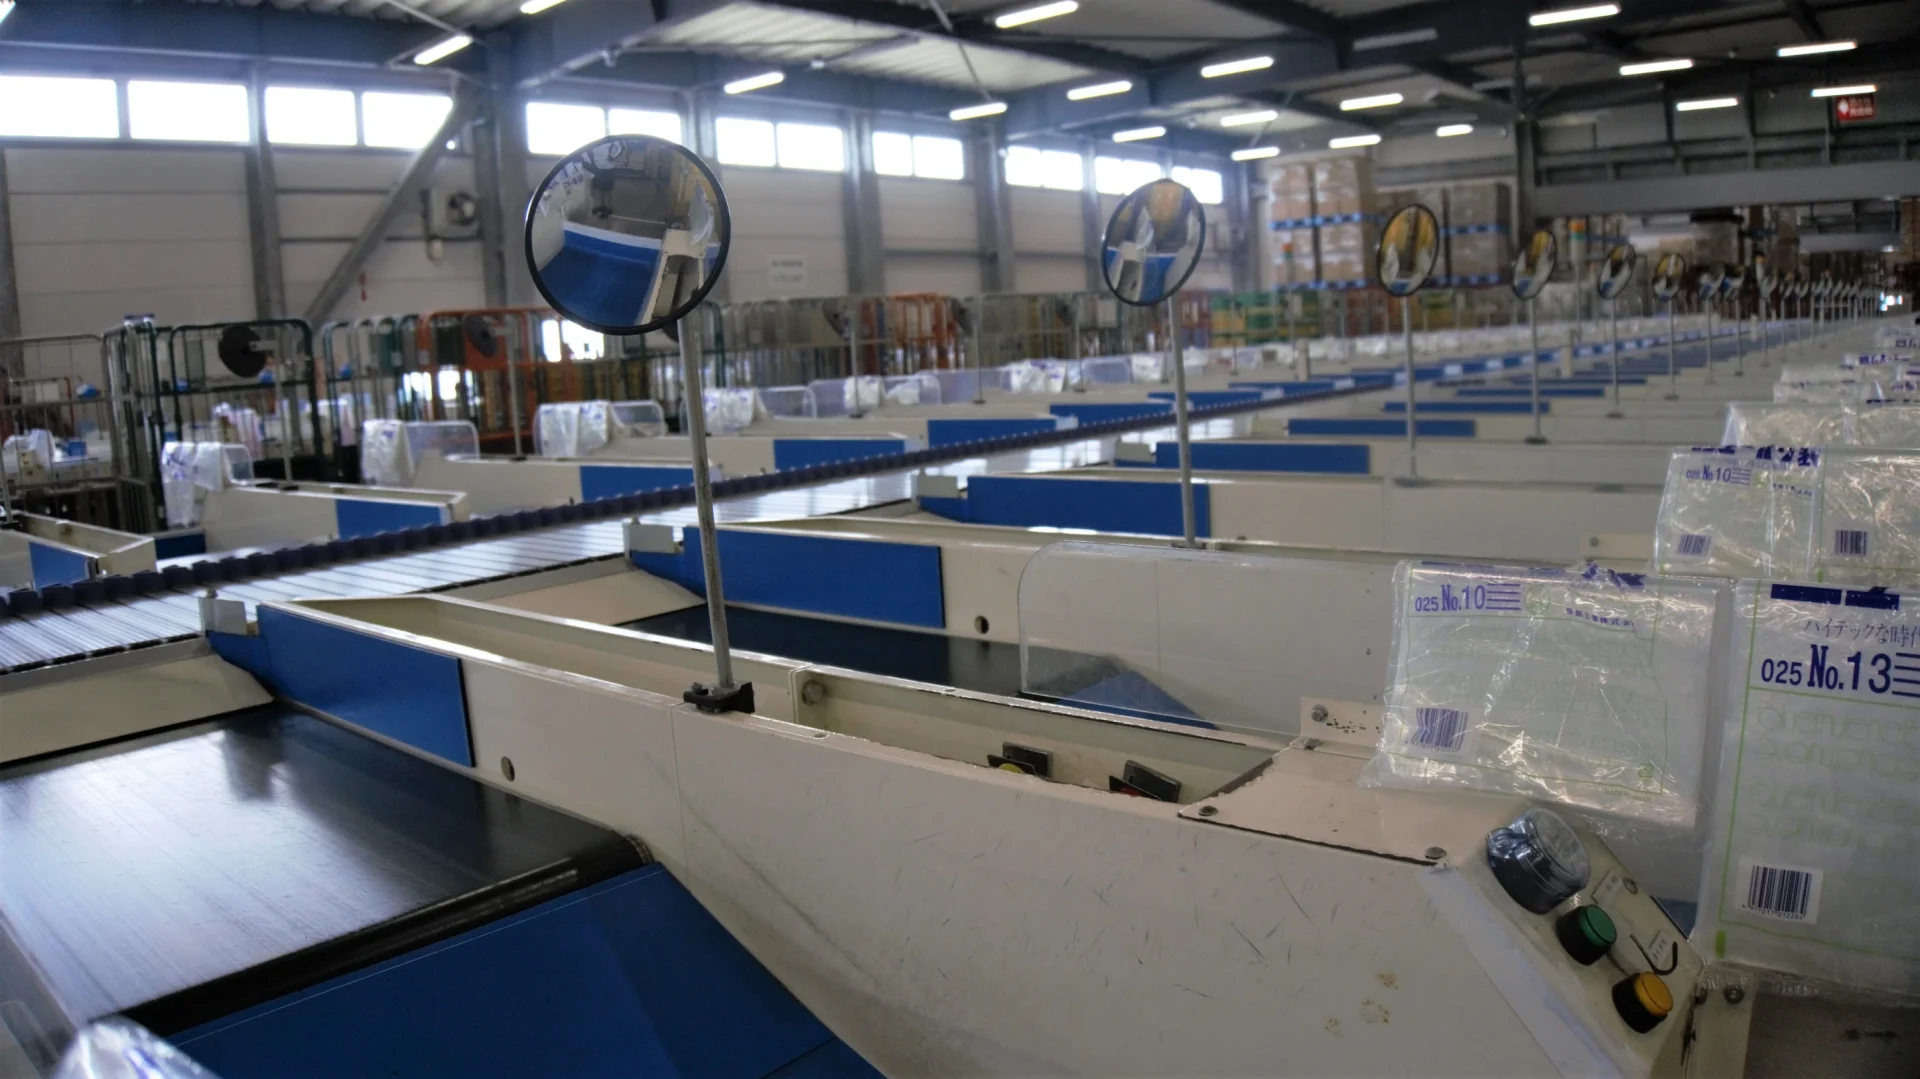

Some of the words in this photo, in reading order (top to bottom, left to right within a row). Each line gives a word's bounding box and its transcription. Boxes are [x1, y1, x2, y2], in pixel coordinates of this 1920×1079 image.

[1415, 596, 1439, 612] 025
[1441, 583, 1486, 612] No.10
[1761, 658, 1802, 686] 025
[1807, 643, 1892, 694] No.13
